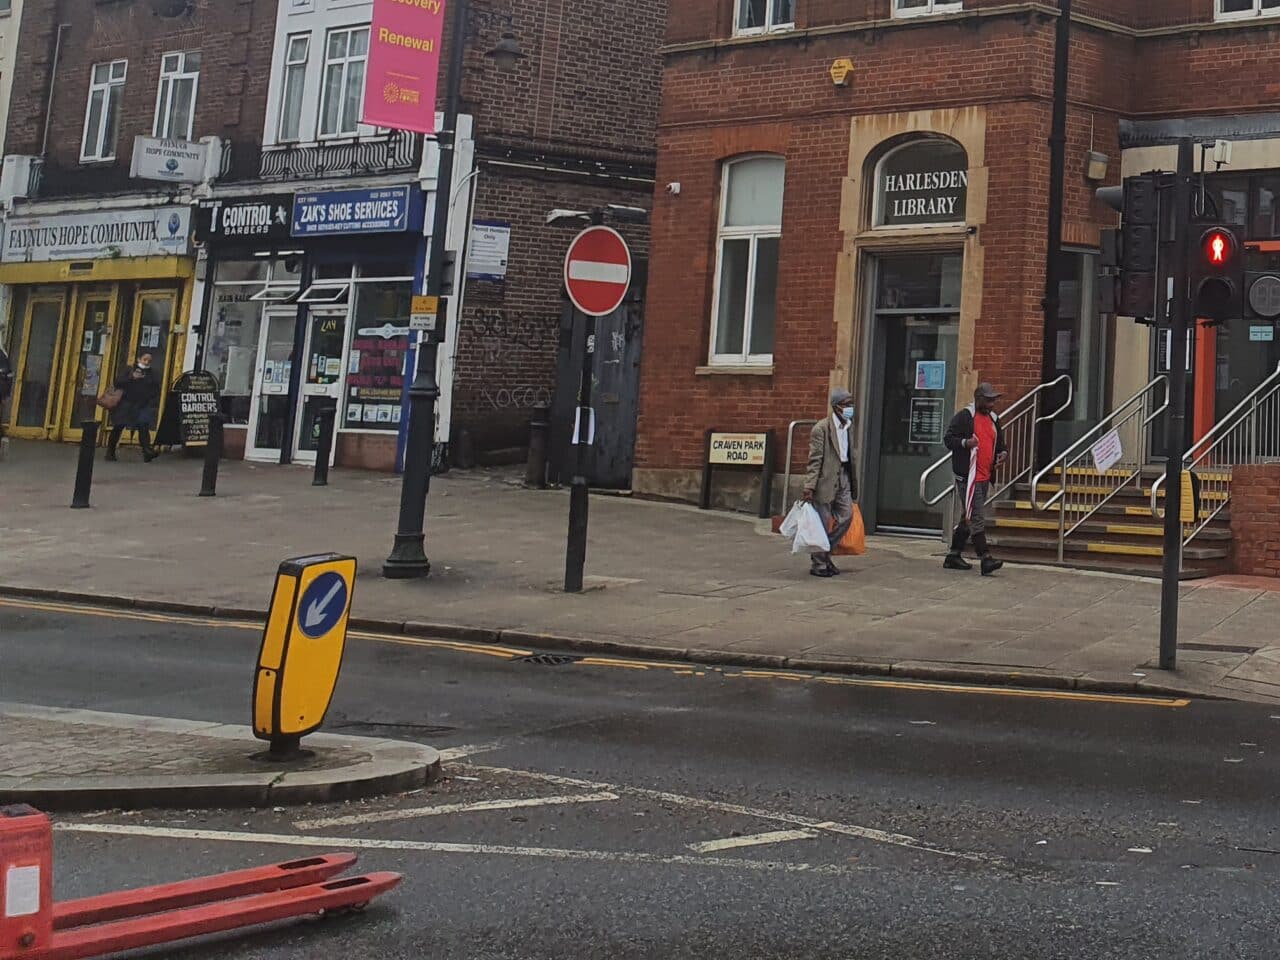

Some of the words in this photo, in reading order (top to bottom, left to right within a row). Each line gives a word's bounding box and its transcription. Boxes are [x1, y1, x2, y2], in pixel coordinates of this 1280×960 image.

[379, 27, 434, 53] Renewal
[885, 170, 968, 192] HARLESDEN
[222, 205, 272, 227] CONTROL
[300, 204, 327, 223] ZAK'S
[327, 202, 353, 221] SHOE
[354, 200, 399, 220] SERVICES
[893, 196, 958, 217] LIBRARY
[9, 227, 57, 248] FAYNUUS
[58, 225, 89, 245] HOPE
[90, 220, 160, 244] COMMUNITY
[224, 225, 269, 235] BARBERS
[181, 393, 217, 402] CONTROL
[182, 403, 218, 413] BARBERS
[713, 440, 743, 450] CRAVEN
[744, 440, 764, 450] PARK
[726, 451, 748, 461] ROAD
